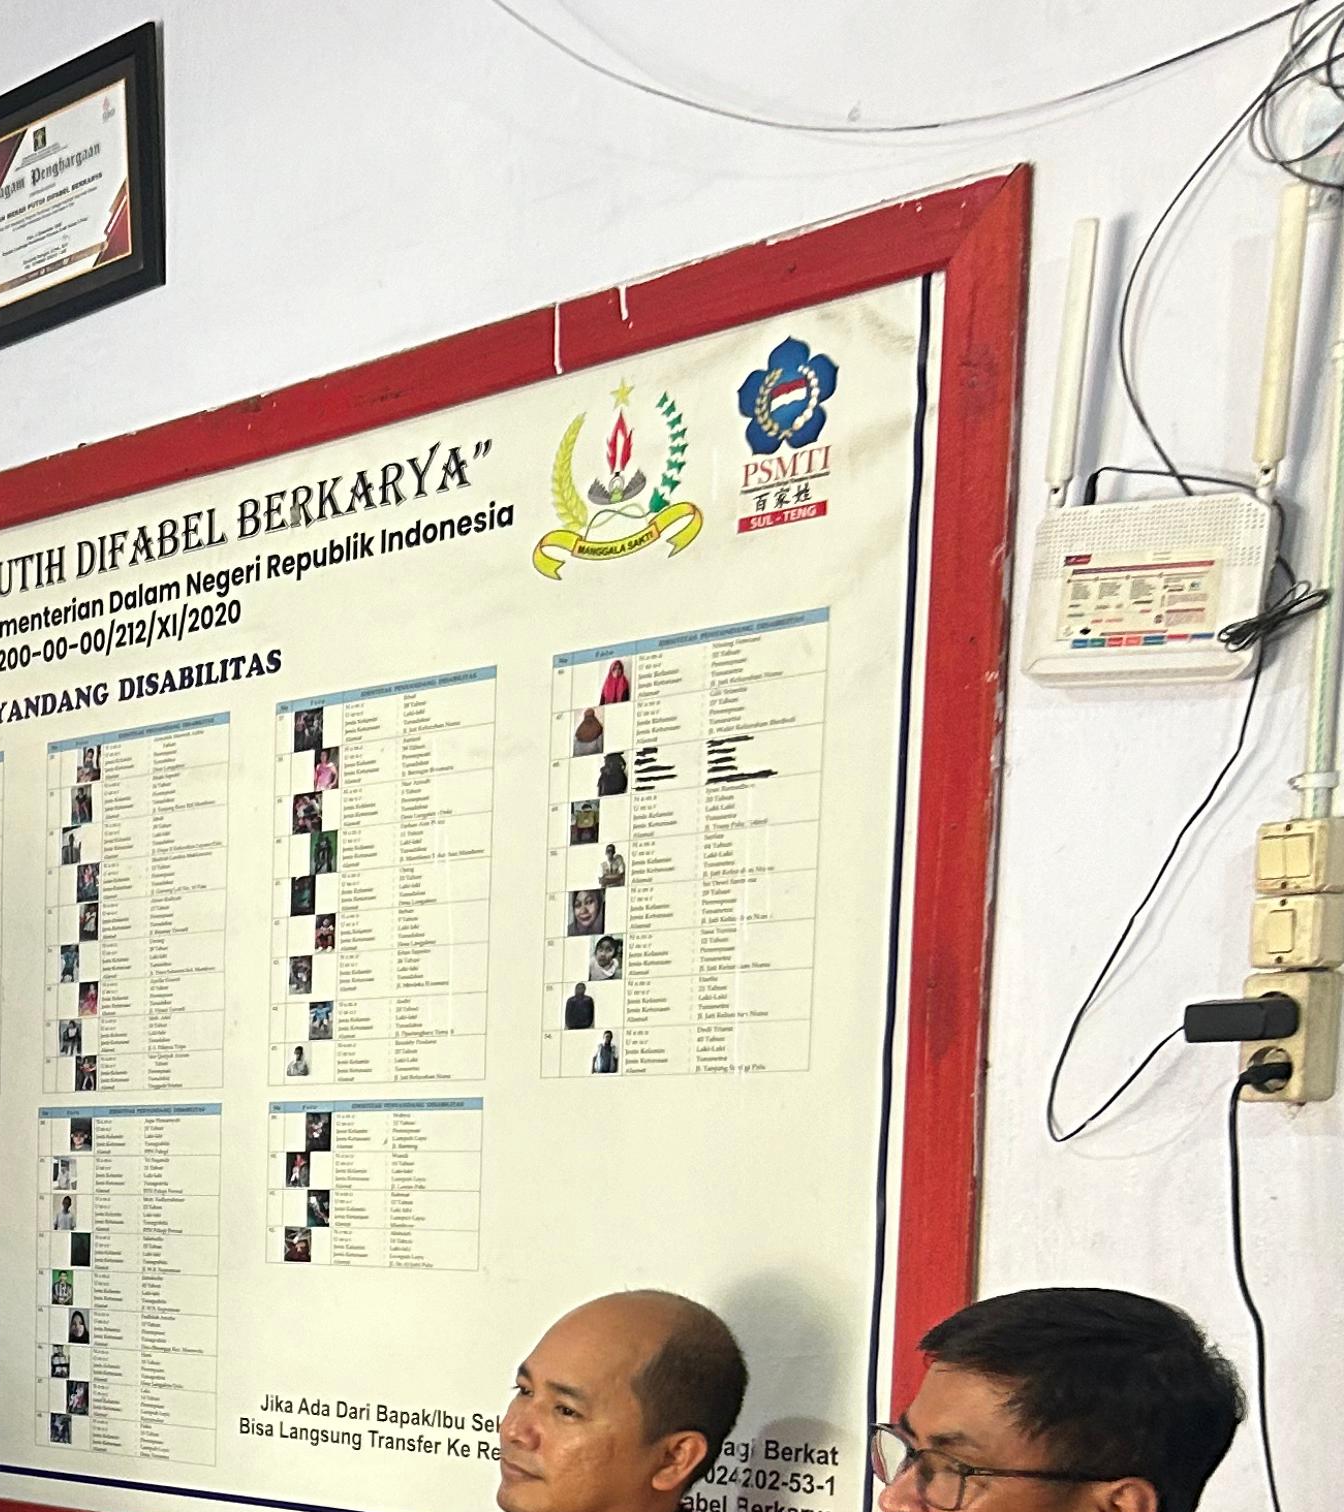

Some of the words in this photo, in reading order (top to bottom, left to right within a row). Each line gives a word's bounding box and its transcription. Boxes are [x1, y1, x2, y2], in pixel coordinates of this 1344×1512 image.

[31, 143, 101, 186] Penghargaan
[742, 445, 832, 488] PSMTI
[749, 515, 774, 529] SUL
[783, 504, 817, 522] TENG
[753, 482, 812, 512] 百家姓
[76, 508, 228, 578] DIFABEL
[109, 573, 181, 613] Dalam
[186, 555, 262, 599] Negeri
[266, 532, 374, 580] Republik
[380, 501, 515, 554] Indonesia
[118, 649, 282, 702] DISABILITAS
[260, 1394, 293, 1413] Jika
[297, 1397, 330, 1417] Ada
[335, 1400, 371, 1421] Dari
[376, 1405, 465, 1430] Bapak/Ibu
[239, 1417, 274, 1436] Bisa
[279, 1421, 362, 1450] Langsung
[368, 1430, 442, 1454] Transfer
[447, 1437, 471, 1457] Ke
[764, 1439, 839, 1466] Berkat
